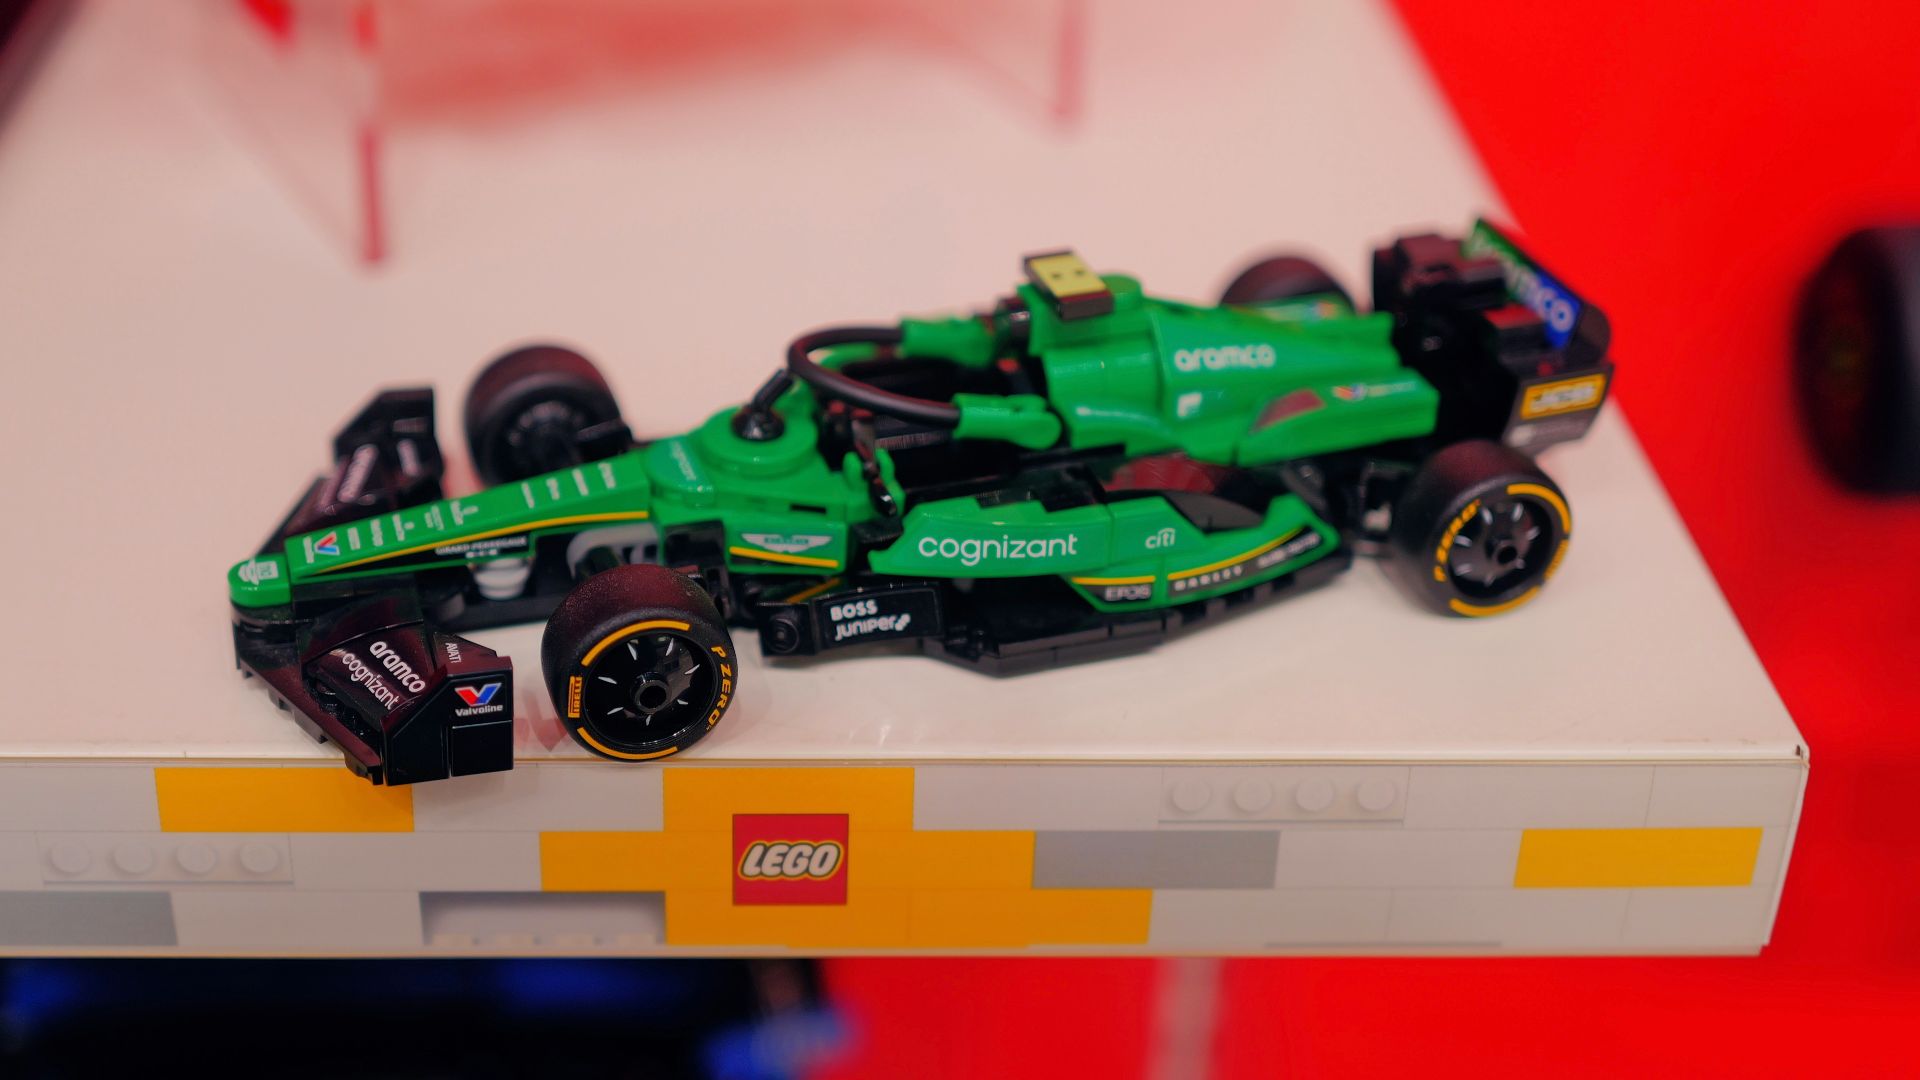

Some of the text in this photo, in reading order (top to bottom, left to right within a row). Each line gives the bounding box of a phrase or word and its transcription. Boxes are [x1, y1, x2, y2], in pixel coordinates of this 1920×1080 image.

[1174, 344, 1277, 371] aramco
[918, 534, 1078, 567] cognizant
[1145, 528, 1176, 549] citi
[830, 600, 878, 622] BOSS
[341, 653, 400, 711] cognizant
[369, 640, 426, 693] aramco
[567, 675, 583, 719] PIRELLI
[708, 645, 732, 727] P ZERO
[455, 704, 504, 717] Valvoline
[740, 841, 841, 880] LEGO
